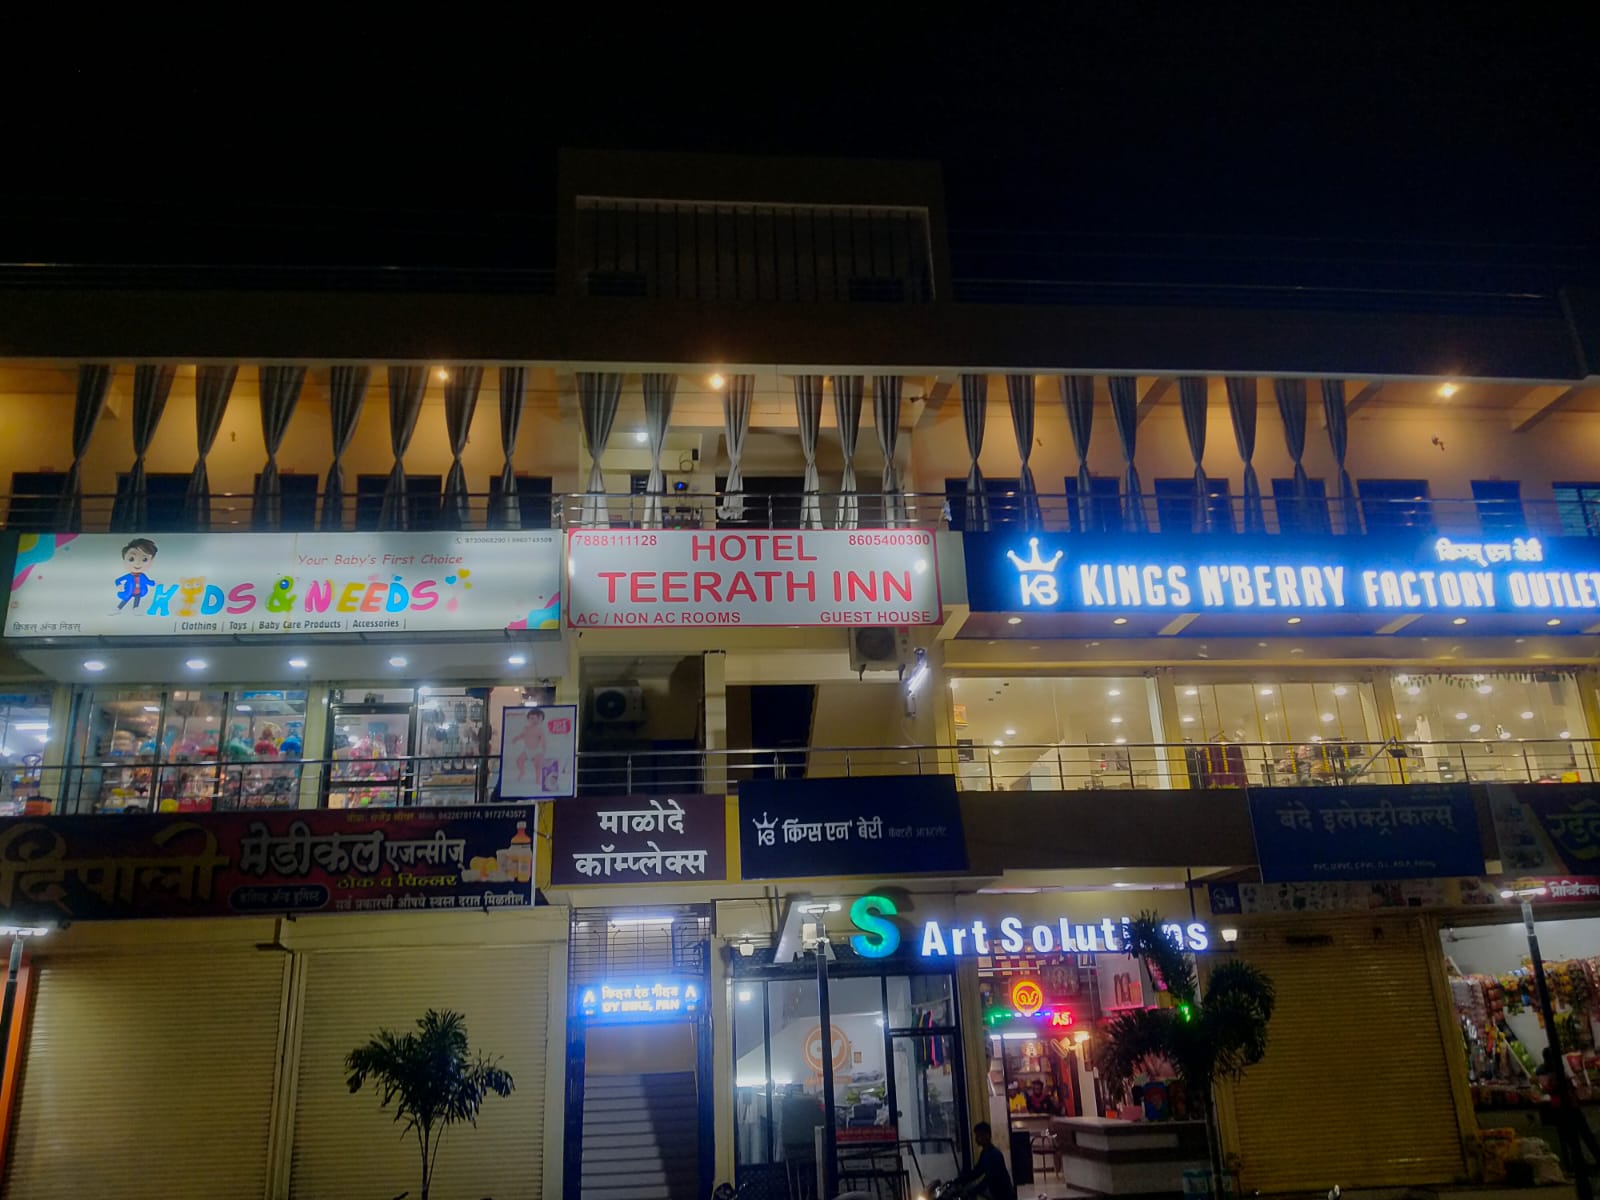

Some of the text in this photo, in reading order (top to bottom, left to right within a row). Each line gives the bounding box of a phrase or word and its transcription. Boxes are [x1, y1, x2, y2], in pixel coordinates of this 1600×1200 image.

[576, 535, 657, 546] 7888111128
[692, 535, 818, 562] HOTEL
[849, 534, 930, 546] 8605400300
[298, 554, 463, 566] Your Baby's First Choice
[597, 570, 912, 603] TEERATH INN
[1079, 564, 1192, 607] KINGS
[1198, 565, 1345, 607] N'BERRY
[1362, 571, 1496, 607] FACTORY
[146, 576, 256, 617] KIDS
[304, 579, 440, 613] NEEDS
[229, 620, 248, 631] Toys
[259, 619, 341, 631] Baby Care Products
[352, 618, 399, 629] Accessories
[576, 613, 599, 625] AC
[614, 612, 648, 625] NON
[654, 612, 676, 624] AC
[682, 612, 741, 624] ROOMS
[820, 611, 931, 623] GUEST HOUSE
[182, 621, 217, 632] Clothing
[597, 799, 686, 834] माळोदे
[856, 816, 884, 840] बेरी
[572, 842, 708, 877] कॉम्प्लेक्स
[850, 895, 900, 958] S
[921, 920, 988, 956] Art
